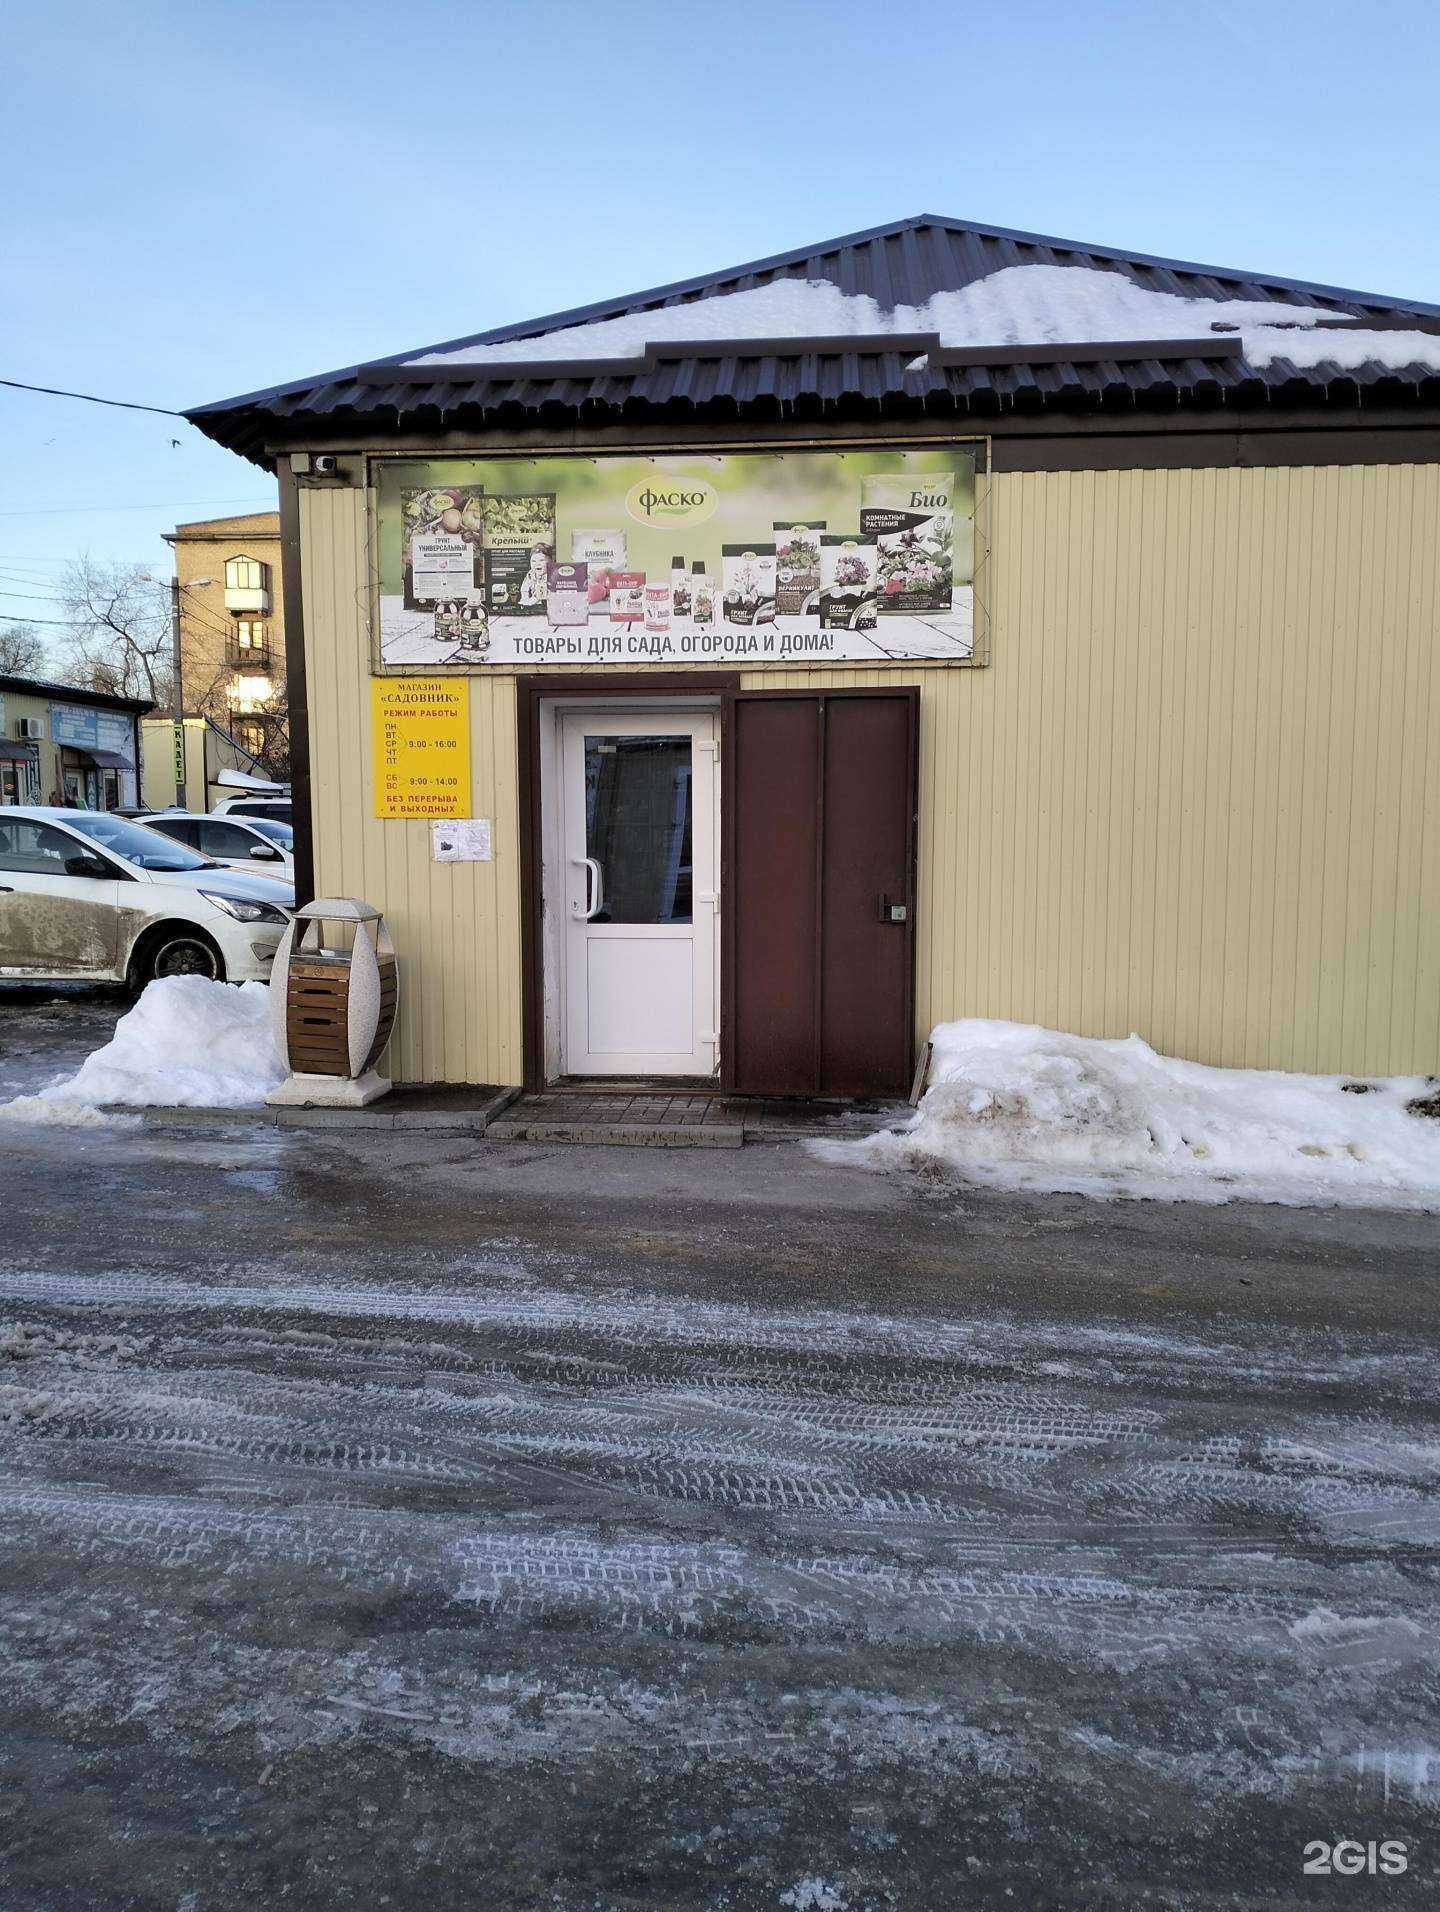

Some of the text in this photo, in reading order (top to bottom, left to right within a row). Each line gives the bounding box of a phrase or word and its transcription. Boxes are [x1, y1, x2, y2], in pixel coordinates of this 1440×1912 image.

[639, 489, 705, 516] ФАСКО
[909, 491, 948, 508] Био
[491, 537, 529, 547] Крепыш
[512, 634, 834, 656] ТОВАРЫ ДЛЯ САДА, ОГОРОДА И ДОМА!
[398, 683, 442, 692] МАГАЗИН
[380, 693, 460, 704] «САДОВНИК»
[383, 709, 458, 717] РЕЖИМ РАБОТЫ
[385, 723, 397, 731] ПН
[385, 731, 397, 739] ВТ
[386, 740, 397, 748] СР
[435, 740, 457, 748] 16:00
[386, 757, 398, 765] ПТ
[386, 782, 398, 790] ВС
[409, 777, 428, 786] 9:00
[435, 777, 458, 786] 14:00
[386, 795, 458, 803] БЕЗ ПЕРЕРЫВА
[389, 805, 456, 814] И ВЫХОДНЫХ
